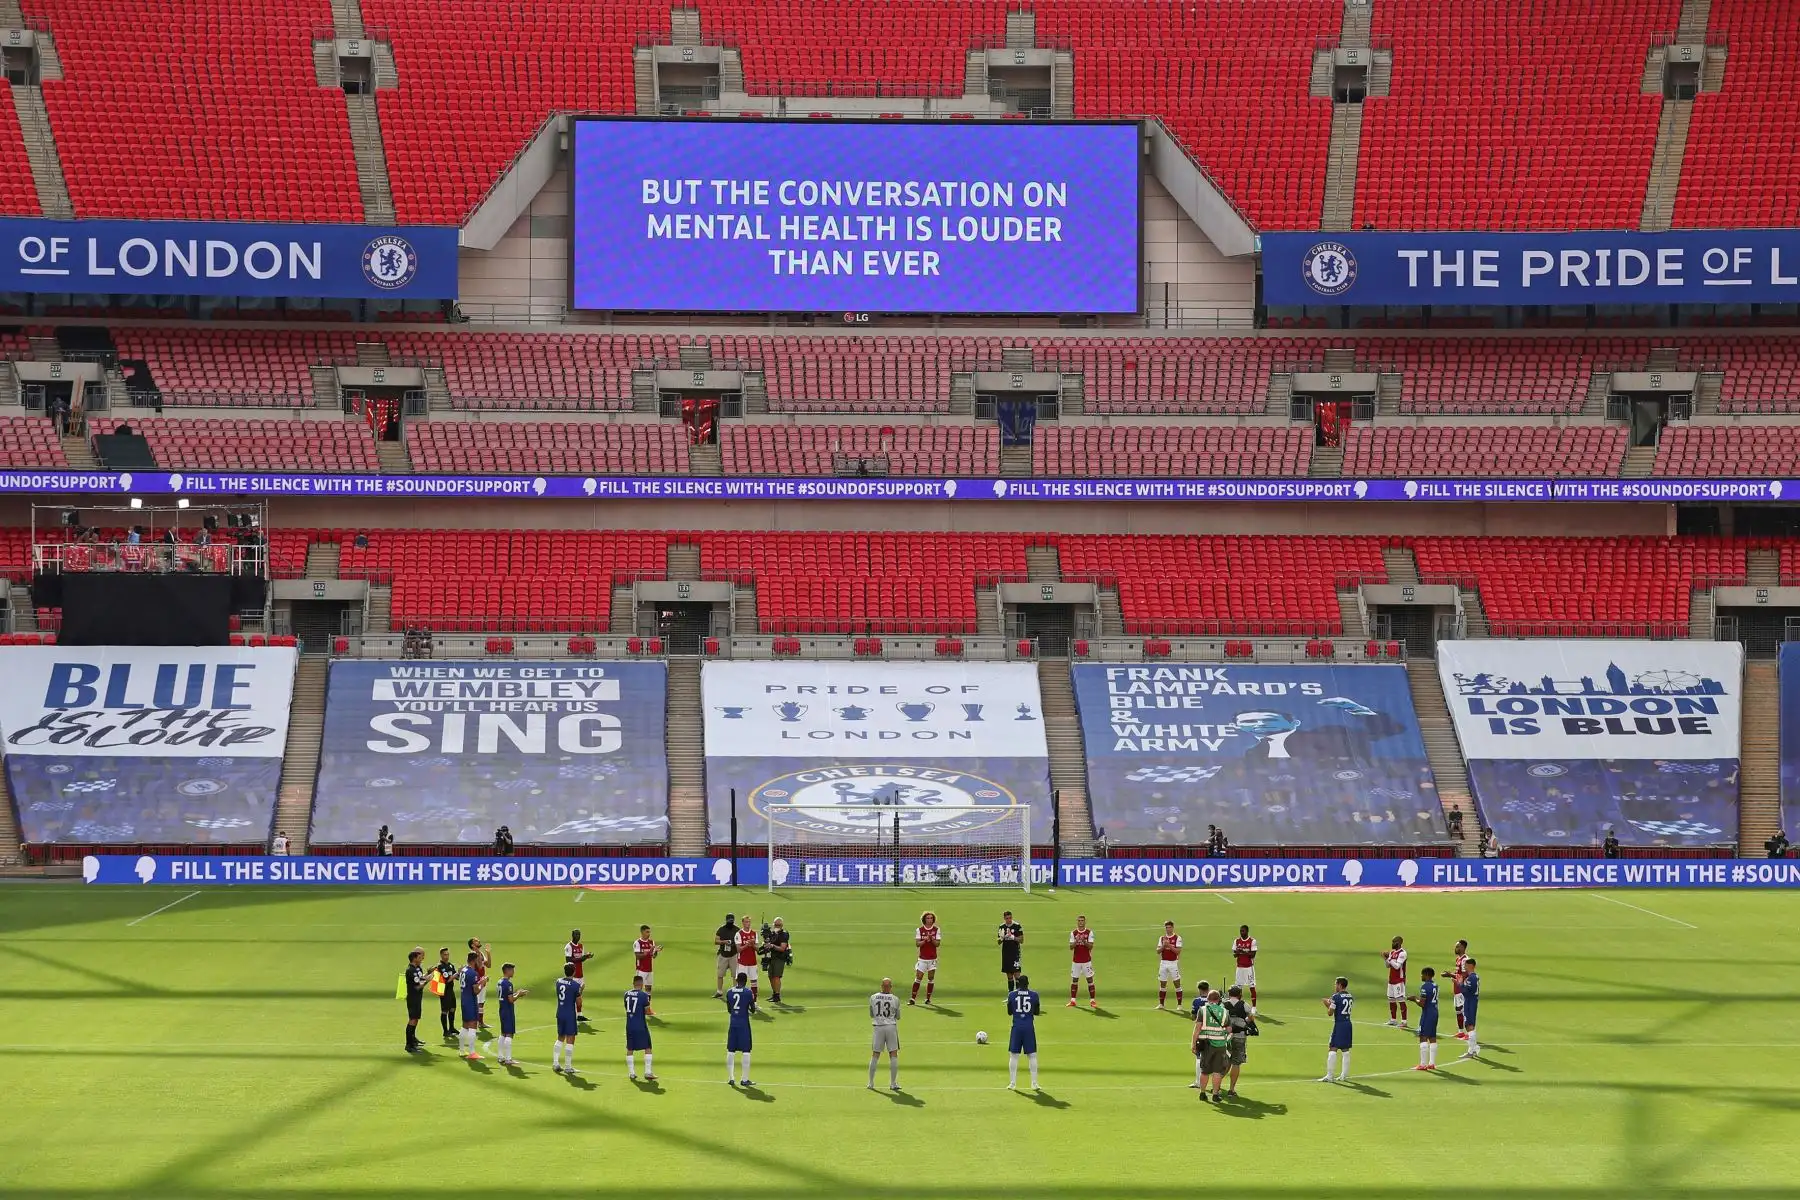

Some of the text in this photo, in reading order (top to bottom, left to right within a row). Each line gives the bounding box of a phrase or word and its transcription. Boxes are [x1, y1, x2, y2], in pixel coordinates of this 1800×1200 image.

[642, 179, 1067, 208] BUT THE CONVERSATION ON
[647, 213, 1062, 242] MENTAL HEALTH IS LOUDER
[371, 237, 407, 250] CHELSEA
[1311, 244, 1347, 256] CHELSEA
[19, 237, 322, 280] OF LONDON
[767, 249, 940, 276] THAN EVER
[1397, 247, 1798, 288] THE PRIDE OF L
[1312, 282, 1335, 293] FOOTBALL
[856, 313, 869, 322] LG
[186, 477, 531, 493] FILL THE SILENCE WITH THE #SOUNDOFSUPPORT
[599, 481, 942, 496] FILL THE SILENCE WITH THE #SOUNDOFSUPPORT
[1010, 483, 1352, 497] FILL THE SILENCE WITH THE #SOUNDOFSUPPORT
[1421, 483, 1767, 497] FILL THE SILENCE WITH THE #SOUNDOFSUPPORT
[390, 667, 604, 678] WHEN WE GET TO
[1106, 667, 1229, 681] FRANK
[43, 663, 256, 710] BLUE
[392, 681, 601, 699] WEMBLEY
[765, 684, 980, 695] PRIDE OF
[1107, 681, 1323, 695] LAMPARD'S
[393, 701, 599, 712] YOU'LL HEAR US
[1109, 696, 1204, 709] BLUE
[1467, 697, 1719, 715] LONDON
[117, 707, 252, 730] THE
[1110, 710, 1142, 723] &
[366, 712, 623, 754] SING
[1110, 724, 1239, 737] WHITE
[1488, 717, 1712, 735] IS BLUE
[7, 725, 277, 748] COLOUR
[781, 730, 972, 740] LONDON
[1113, 738, 1225, 751] ARMY
[796, 767, 961, 784] CHELSEA
[921, 820, 973, 833] CLUB
[171, 861, 698, 882] FILL THE SILENCE WITH THE #SOUNDOFSUPPORT
[804, 864, 850, 882] FILL
[855, 864, 895, 882] THE
[1061, 864, 1104, 883] THE
[1109, 864, 1328, 883] #SOUNDOFSUPPORT
[1433, 864, 1478, 883] FILL
[1482, 864, 1525, 883] THE
[1530, 864, 1618, 883] SILENCE
[1623, 864, 1680, 883] WITH
[1685, 864, 1727, 883] THE
[558, 984, 566, 1001] 3
[626, 996, 638, 1013] 17
[733, 993, 741, 1010] 2
[875, 1001, 891, 1018] 13
[1015, 996, 1031, 1013] 15
[1341, 998, 1354, 1015] 28
